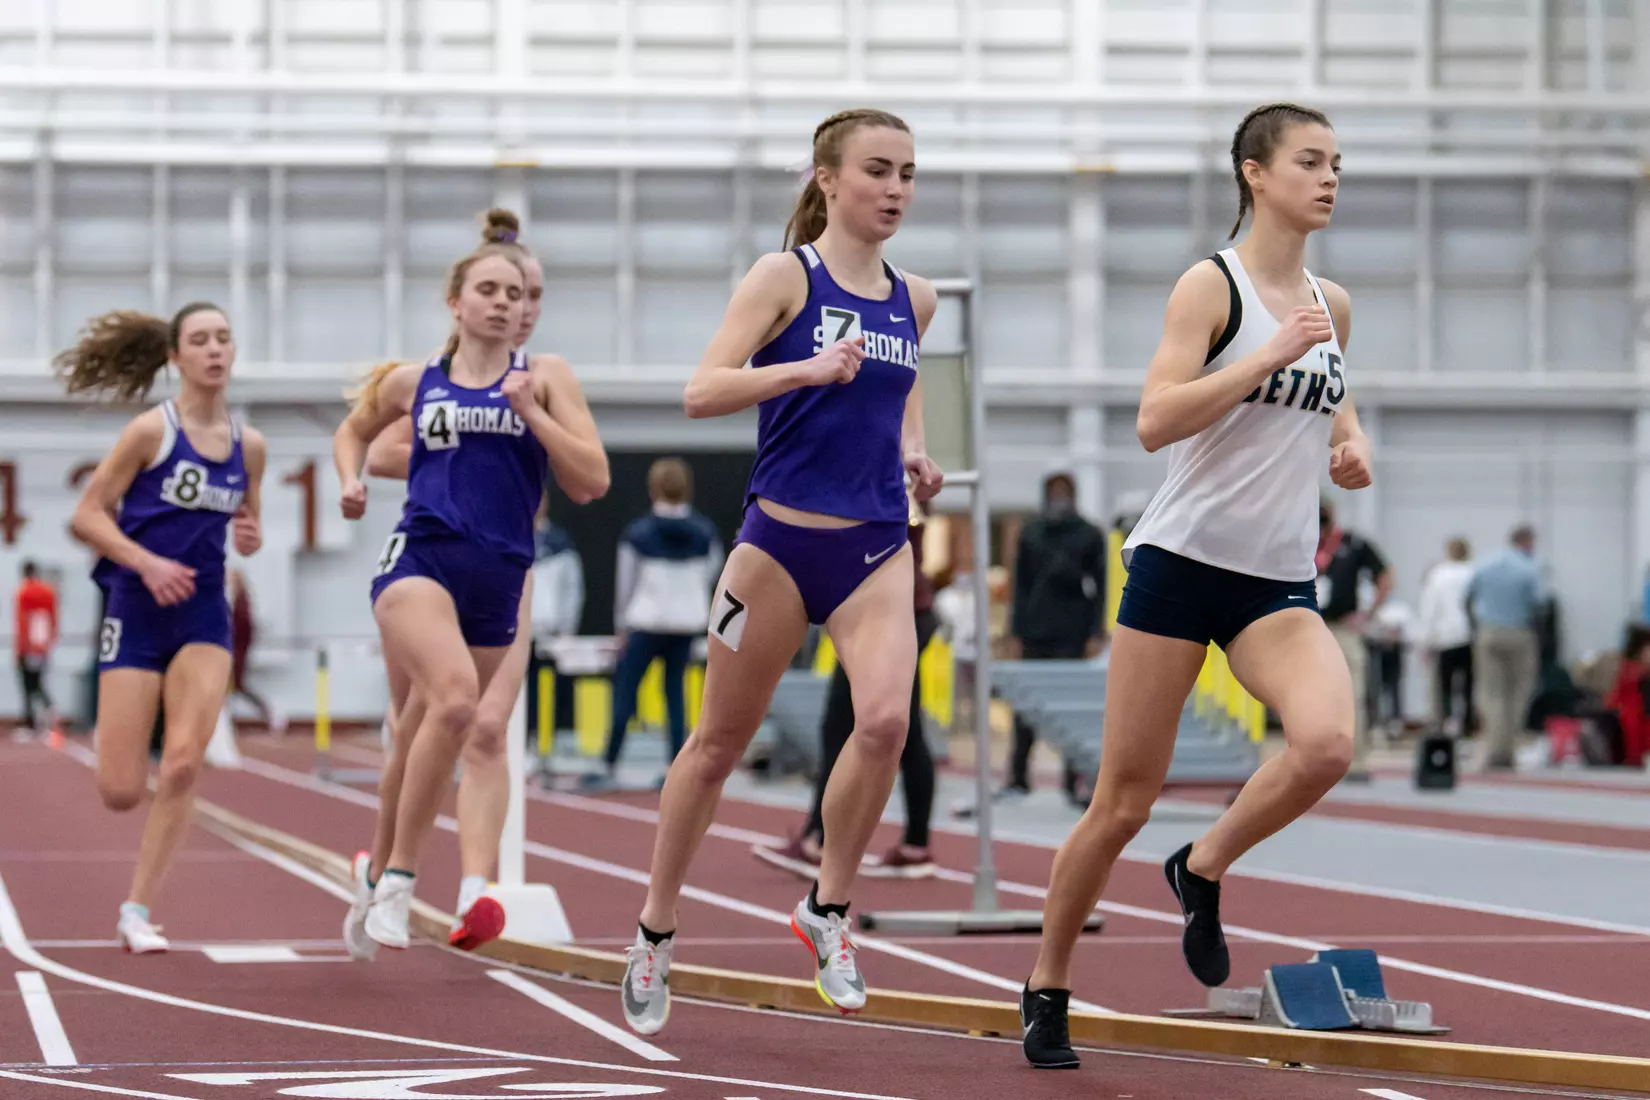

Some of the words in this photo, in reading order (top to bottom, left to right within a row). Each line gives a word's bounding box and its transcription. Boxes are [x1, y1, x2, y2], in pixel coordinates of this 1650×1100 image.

[825, 308, 856, 343] 7
[861, 329, 919, 371] HOMAS
[1241, 366, 1335, 417] ETH
[1326, 352, 1345, 405] 5
[428, 406, 451, 445] 4
[457, 406, 525, 437] HOMAS
[176, 468, 201, 502] 8
[717, 588, 745, 637] 7
